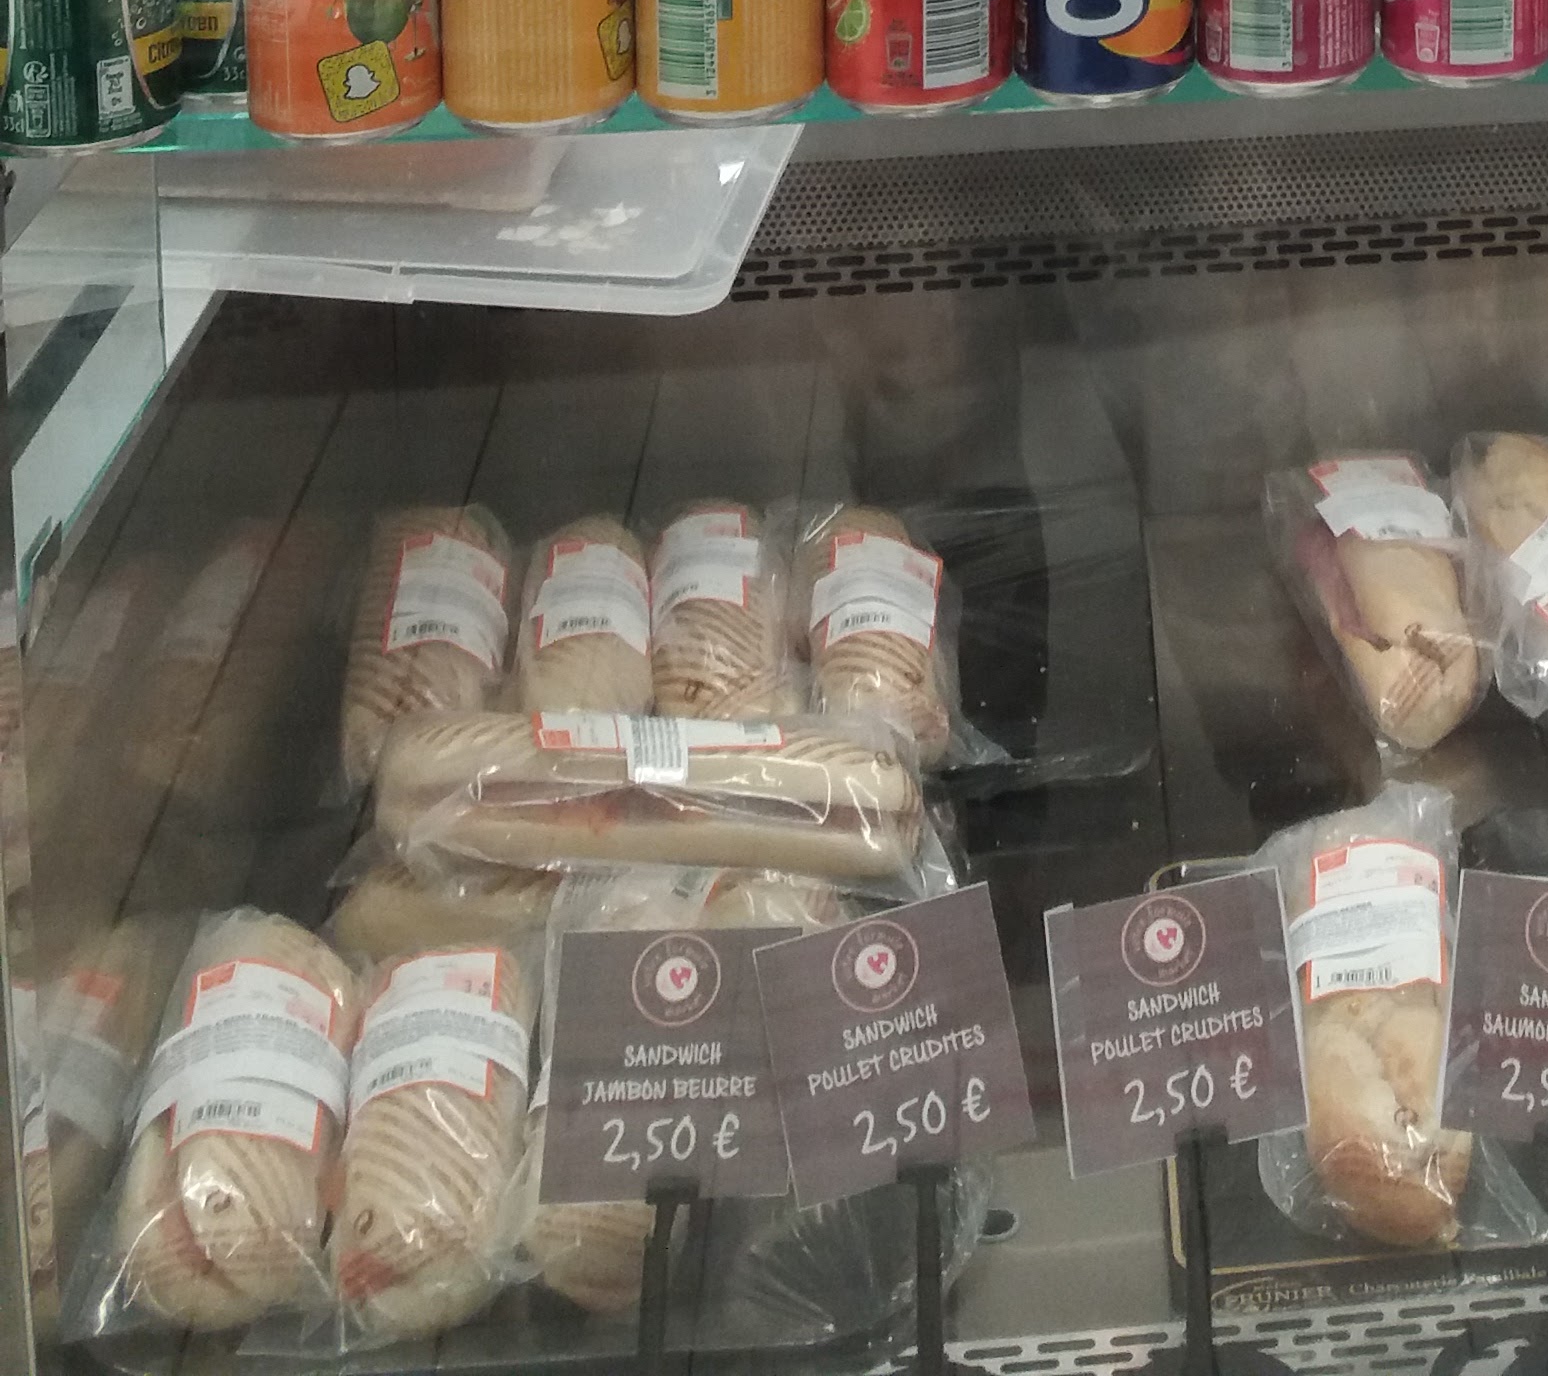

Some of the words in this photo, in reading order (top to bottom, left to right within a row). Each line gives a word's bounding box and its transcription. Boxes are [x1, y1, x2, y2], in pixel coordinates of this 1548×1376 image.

[1127, 981, 1221, 1021] SANDWICH
[842, 1003, 938, 1051] SANDWICH
[1090, 1028, 1165, 1066] POULET
[1171, 1006, 1264, 1046] CRUDITES
[624, 1041, 723, 1068] SANDWICH
[808, 1053, 885, 1096] POULET
[889, 1024, 985, 1071] CRUDITES
[582, 1079, 668, 1105] JAMBON
[673, 1076, 757, 1100] BEURRE
